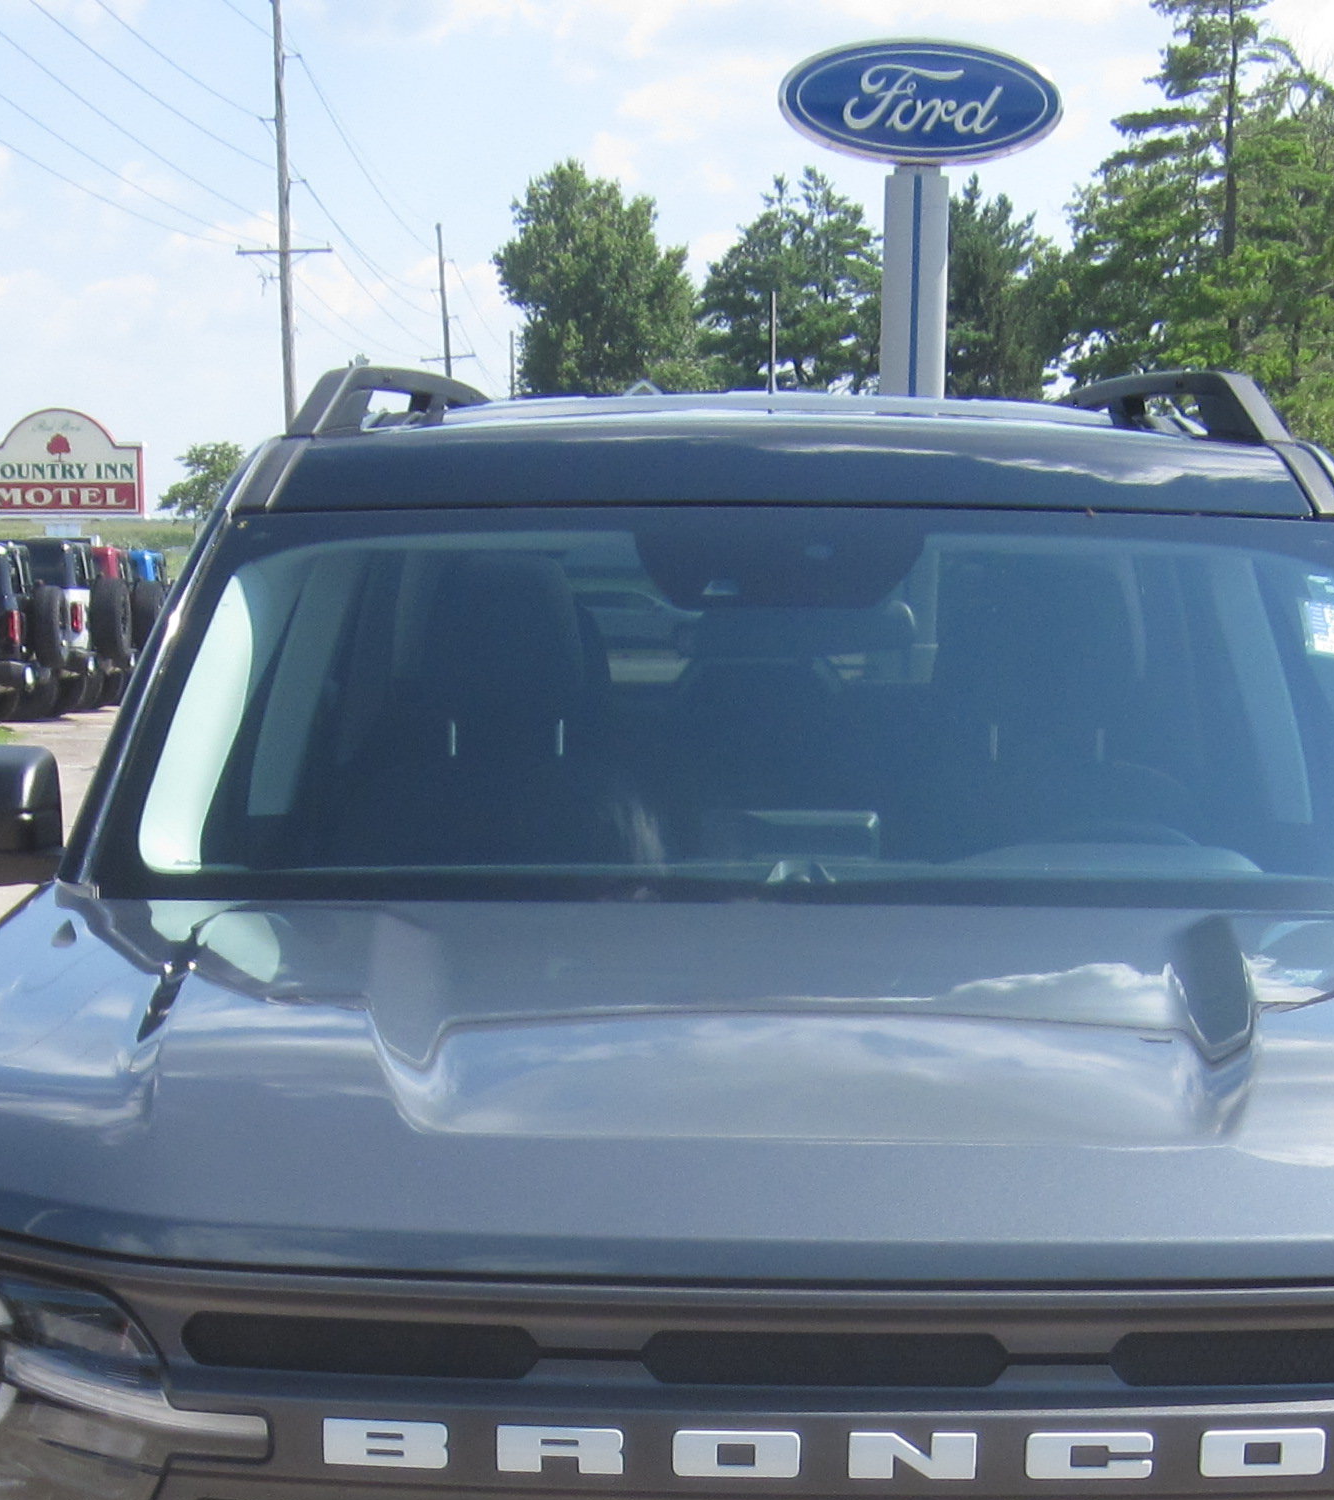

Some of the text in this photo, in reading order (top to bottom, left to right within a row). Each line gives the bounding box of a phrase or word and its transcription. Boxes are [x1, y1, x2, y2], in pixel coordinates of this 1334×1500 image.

[842, 63, 1003, 134] Ford
[96, 463, 135, 480] INN
[322, 1417, 1327, 1480] BRONCO
